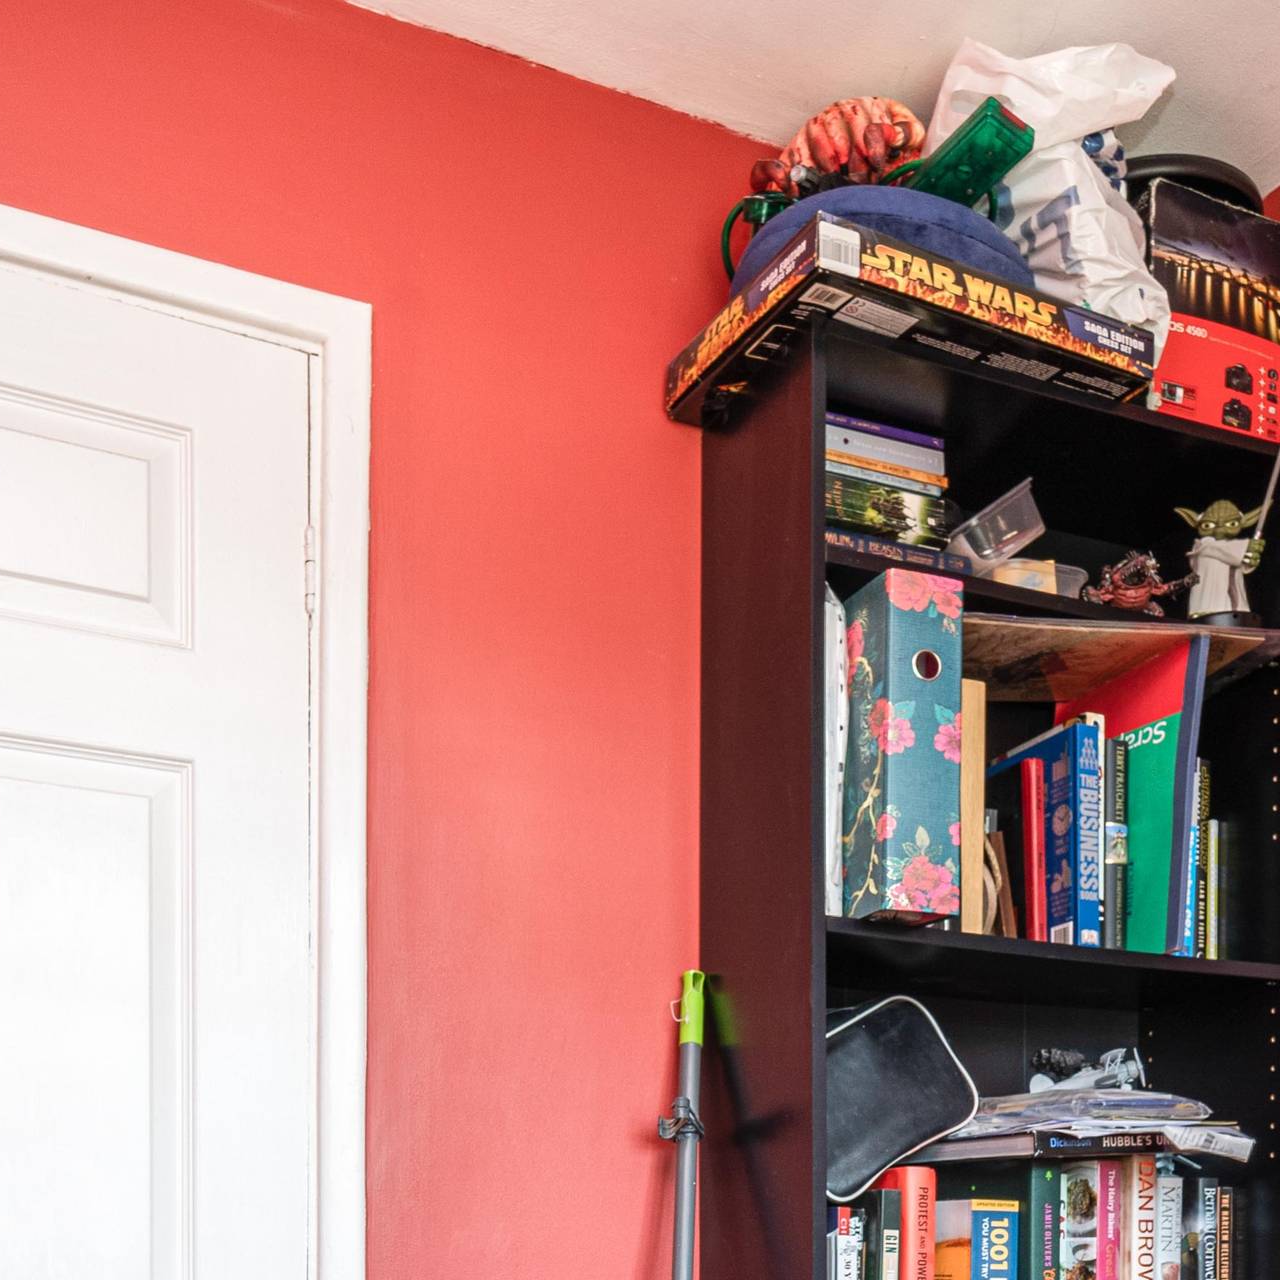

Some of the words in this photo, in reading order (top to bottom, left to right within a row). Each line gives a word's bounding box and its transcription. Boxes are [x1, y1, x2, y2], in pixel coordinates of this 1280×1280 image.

[862, 243, 963, 297] STAR
[962, 272, 1057, 326] WARS
[1083, 320, 1109, 338] SAGA
[1110, 331, 1145, 352] EDITION
[1097, 336, 1120, 350] CHESS
[1120, 344, 1132, 355] SET
[1115, 746, 1125, 771] TERRY
[1079, 774, 1099, 788] THE
[1115, 772, 1125, 822] PRATCHETT
[1079, 787, 1100, 890] BUSINESS
[1198, 880, 1206, 899] ALAN
[1197, 922, 1205, 949] FOSTER
[1102, 1135, 1152, 1147] HUBBLE'S
[1107, 1169, 1116, 1187] The
[1138, 1161, 1155, 1211] DAN
[917, 1186, 928, 1233] PROTEST
[1106, 1188, 1116, 1212] Hairy
[1204, 1187, 1217, 1232] Bernard
[1220, 1194, 1229, 1209] THE
[981, 1217, 990, 1236] YOU
[1044, 1203, 1053, 1230] JAMIE
[1105, 1213, 1115, 1240] Bikers'
[1161, 1186, 1176, 1252] MARTIN
[1220, 1210, 1229, 1241] HARLEM
[885, 1234, 897, 1254] GIN
[981, 1237, 989, 1261] MUST
[989, 1218, 1009, 1271] 1001
[1043, 1231, 1053, 1267] OLIVER'S
[843, 1258, 852, 1270] 30
[980, 1262, 989, 1279] TRY
[1104, 1244, 1114, 1278] Great
